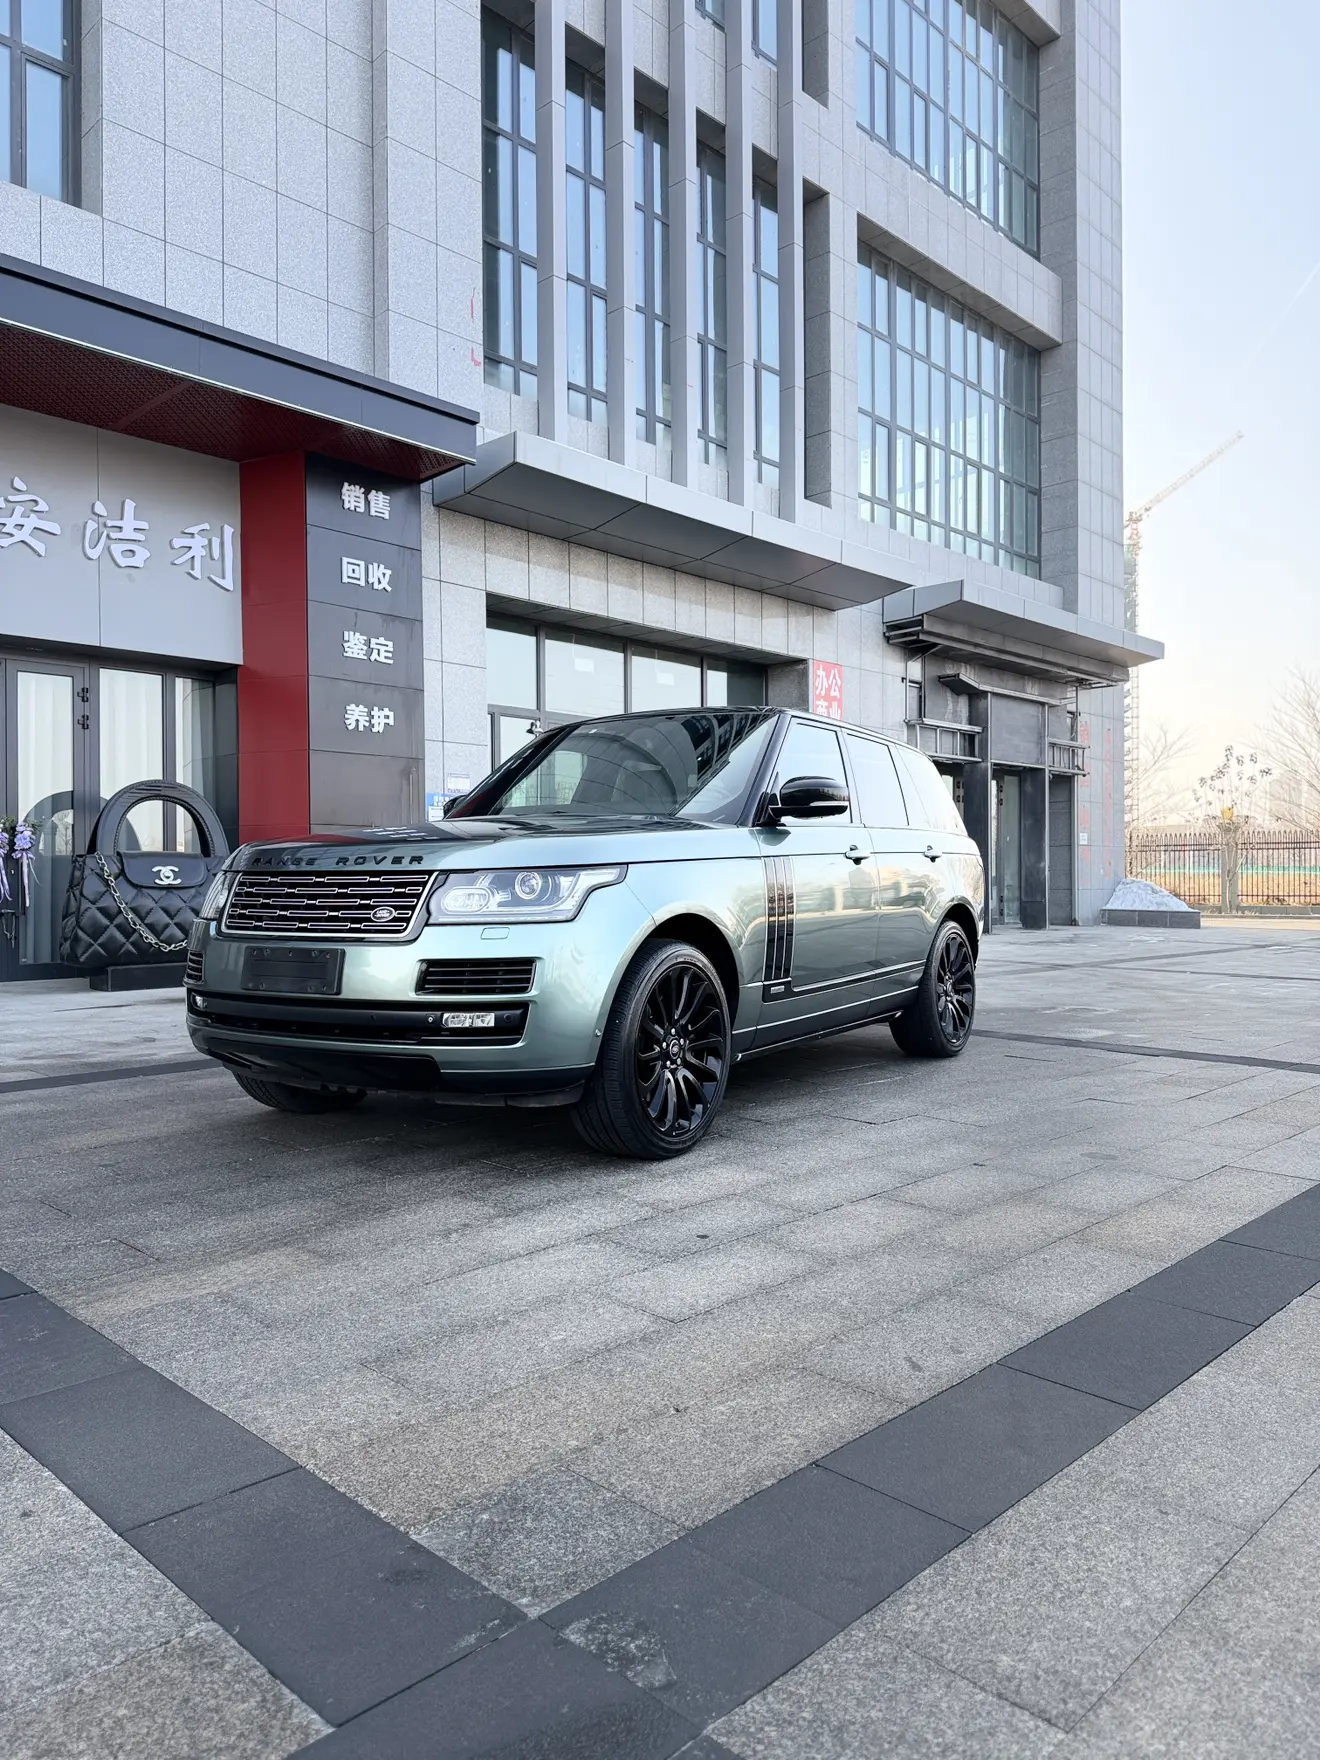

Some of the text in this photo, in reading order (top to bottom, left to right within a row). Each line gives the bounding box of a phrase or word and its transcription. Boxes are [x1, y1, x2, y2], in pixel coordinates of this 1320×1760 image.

[341, 481, 391, 520] 销售
[0, 476, 235, 592] 安洁利
[341, 556, 392, 592] 回收
[342, 630, 394, 665] 鉴定
[815, 664, 842, 698] 办公
[344, 703, 395, 733] 养护
[251, 855, 424, 866] RANGE ROVER
